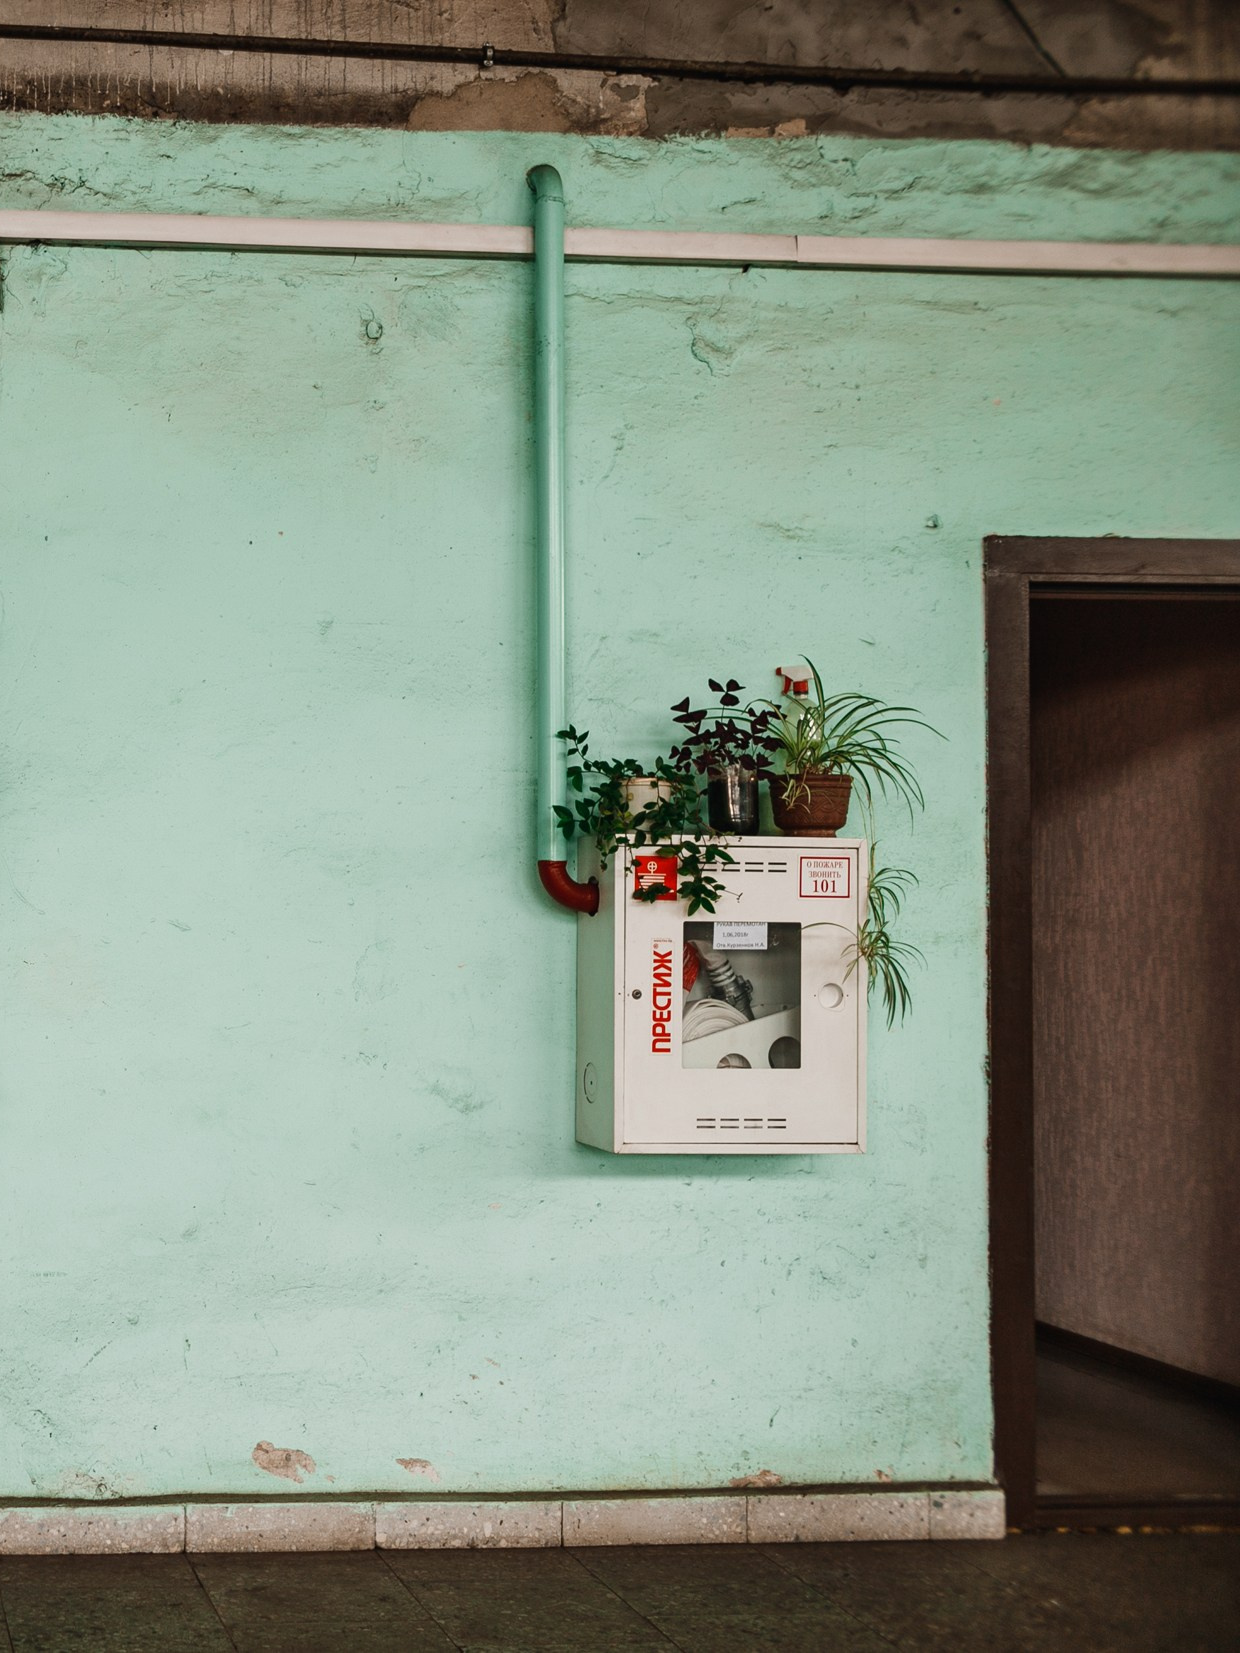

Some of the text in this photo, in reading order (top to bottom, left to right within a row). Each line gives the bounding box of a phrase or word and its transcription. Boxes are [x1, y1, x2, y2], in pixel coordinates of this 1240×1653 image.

[813, 861, 843, 869] ПОЖАРЕ
[813, 879, 837, 893] 101
[652, 950, 672, 1053] ПРЕСТИЖ
